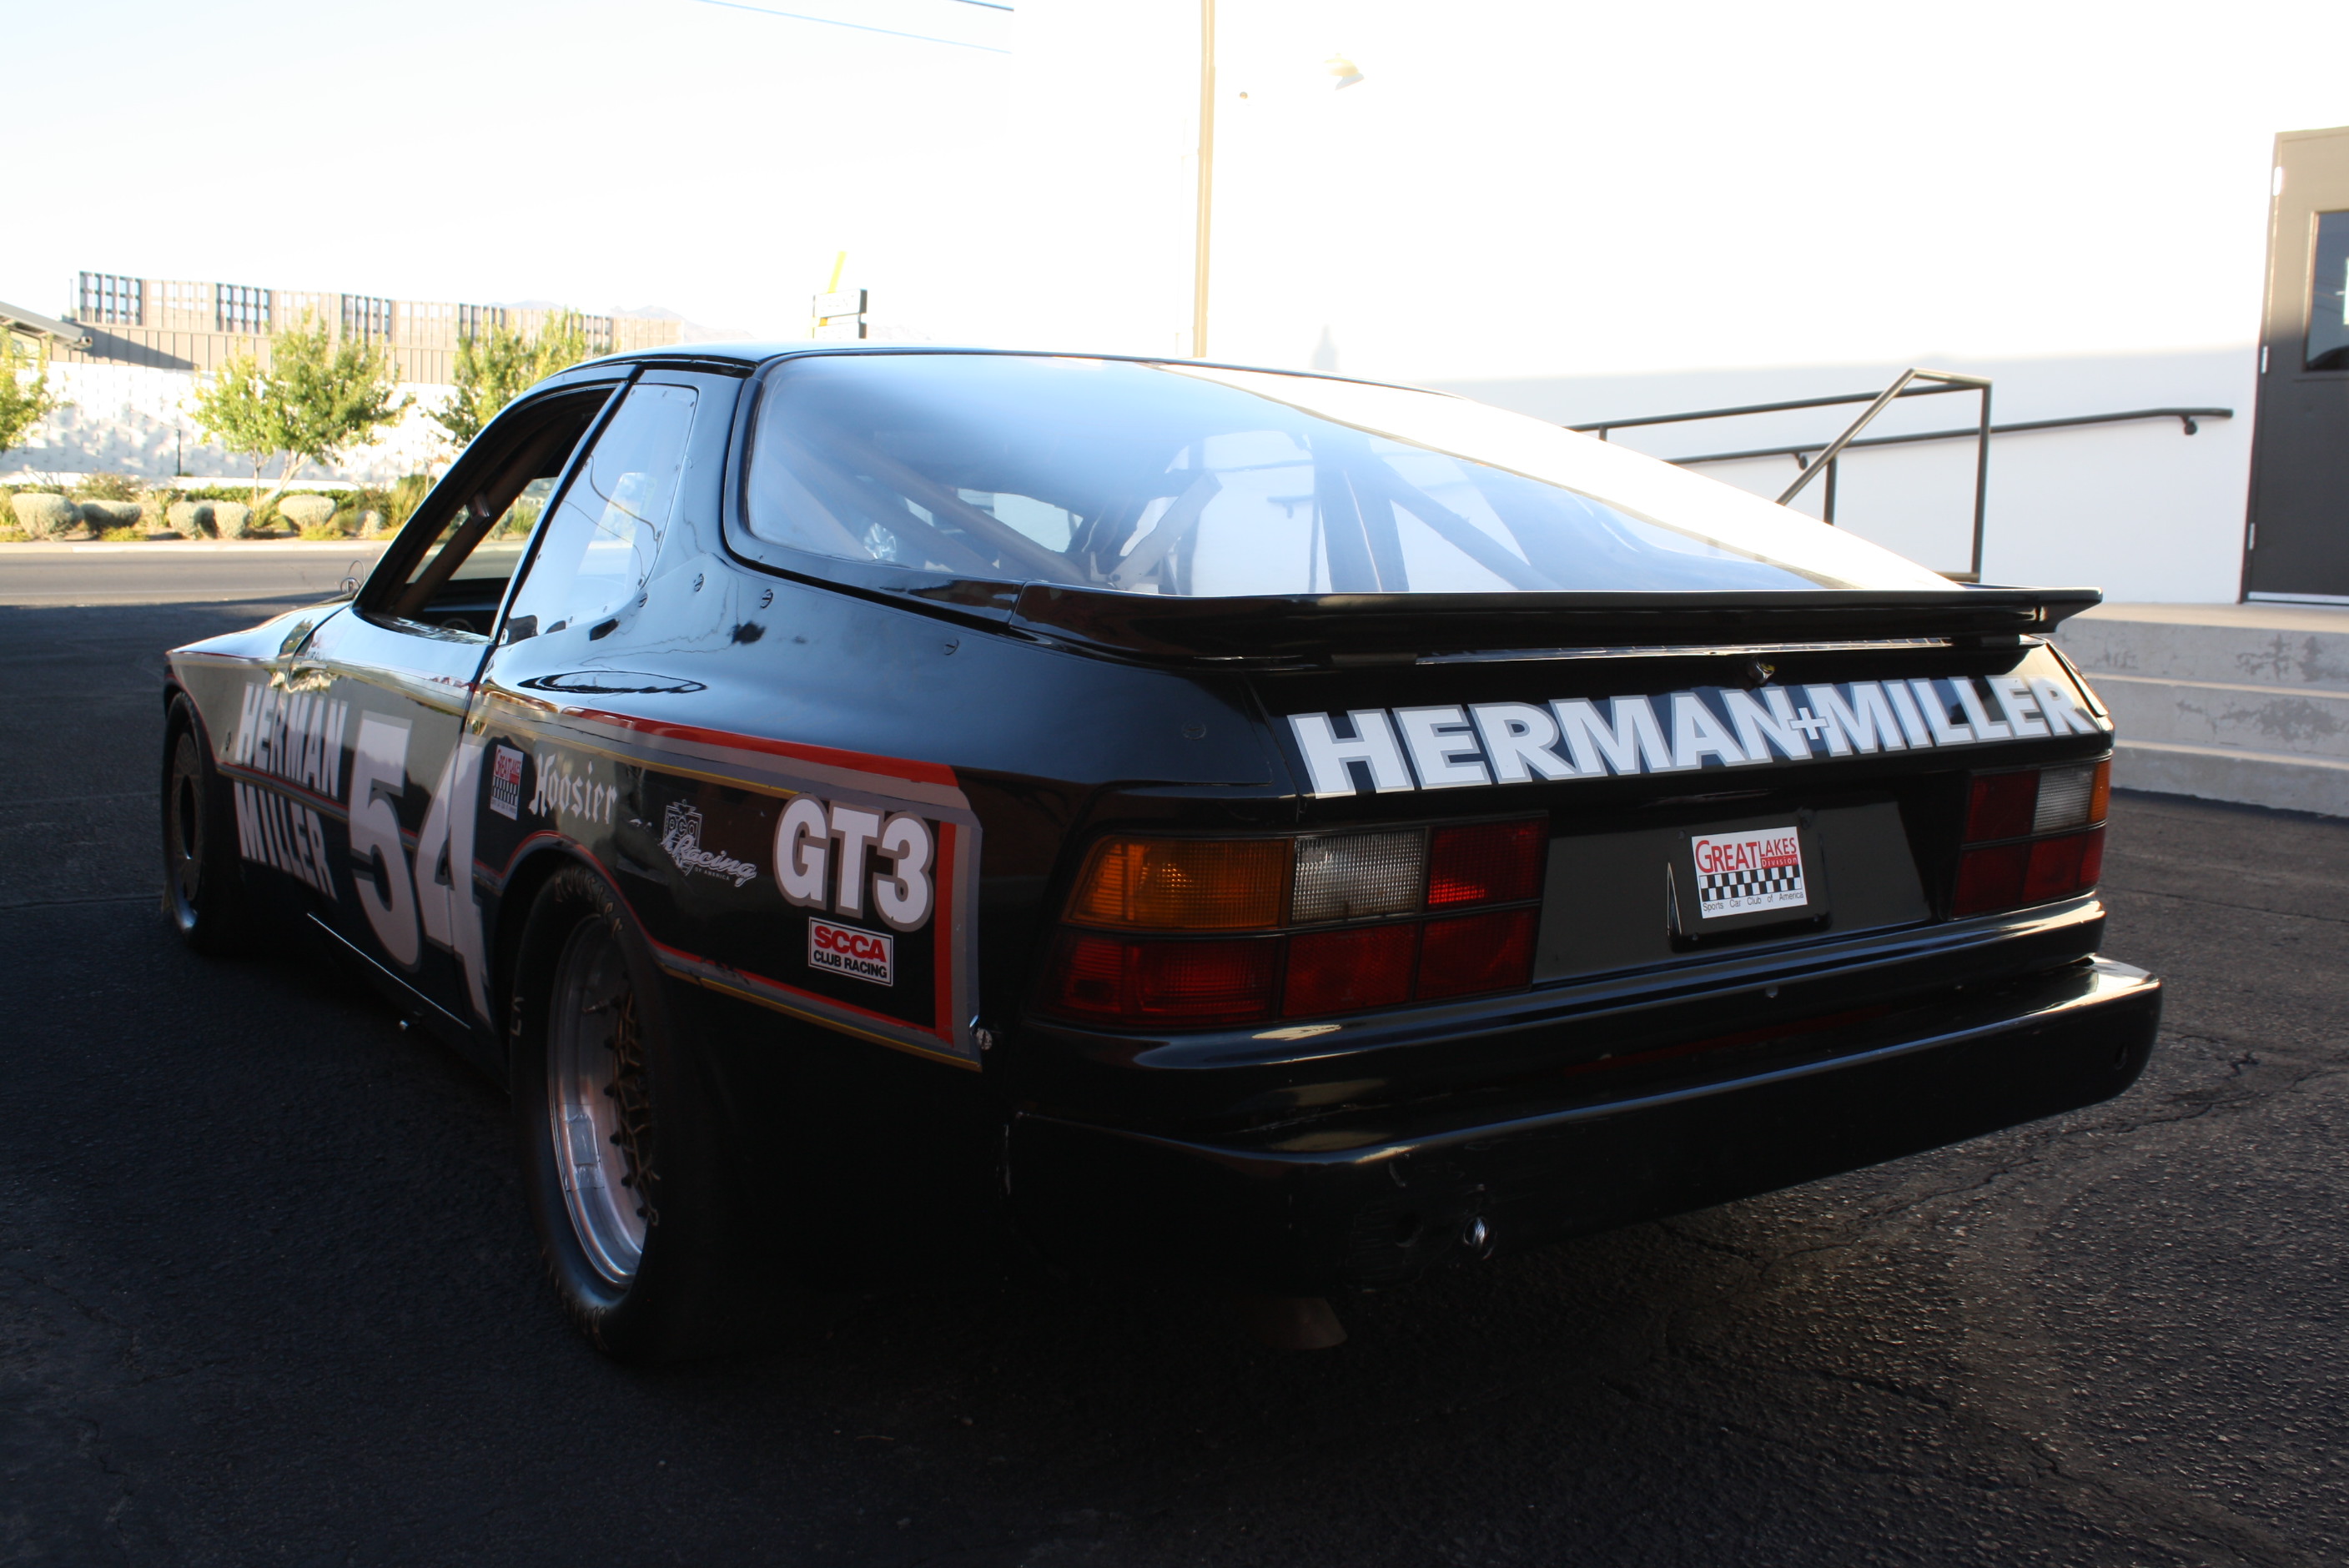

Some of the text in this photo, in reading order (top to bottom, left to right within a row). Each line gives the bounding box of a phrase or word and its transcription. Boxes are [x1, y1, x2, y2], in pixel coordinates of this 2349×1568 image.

[234, 681, 348, 802] HERMAN
[528, 752, 617, 825] Hoosier
[234, 781, 339, 903] MILLER
[348, 711, 493, 1032] 54
[772, 792, 934, 932] GT3
[1761, 856, 1798, 868] Division
[1703, 891, 1804, 912] Sports Car Club of America
[813, 949, 888, 979] CLUB RACING
[814, 925, 887, 963] SCCA
